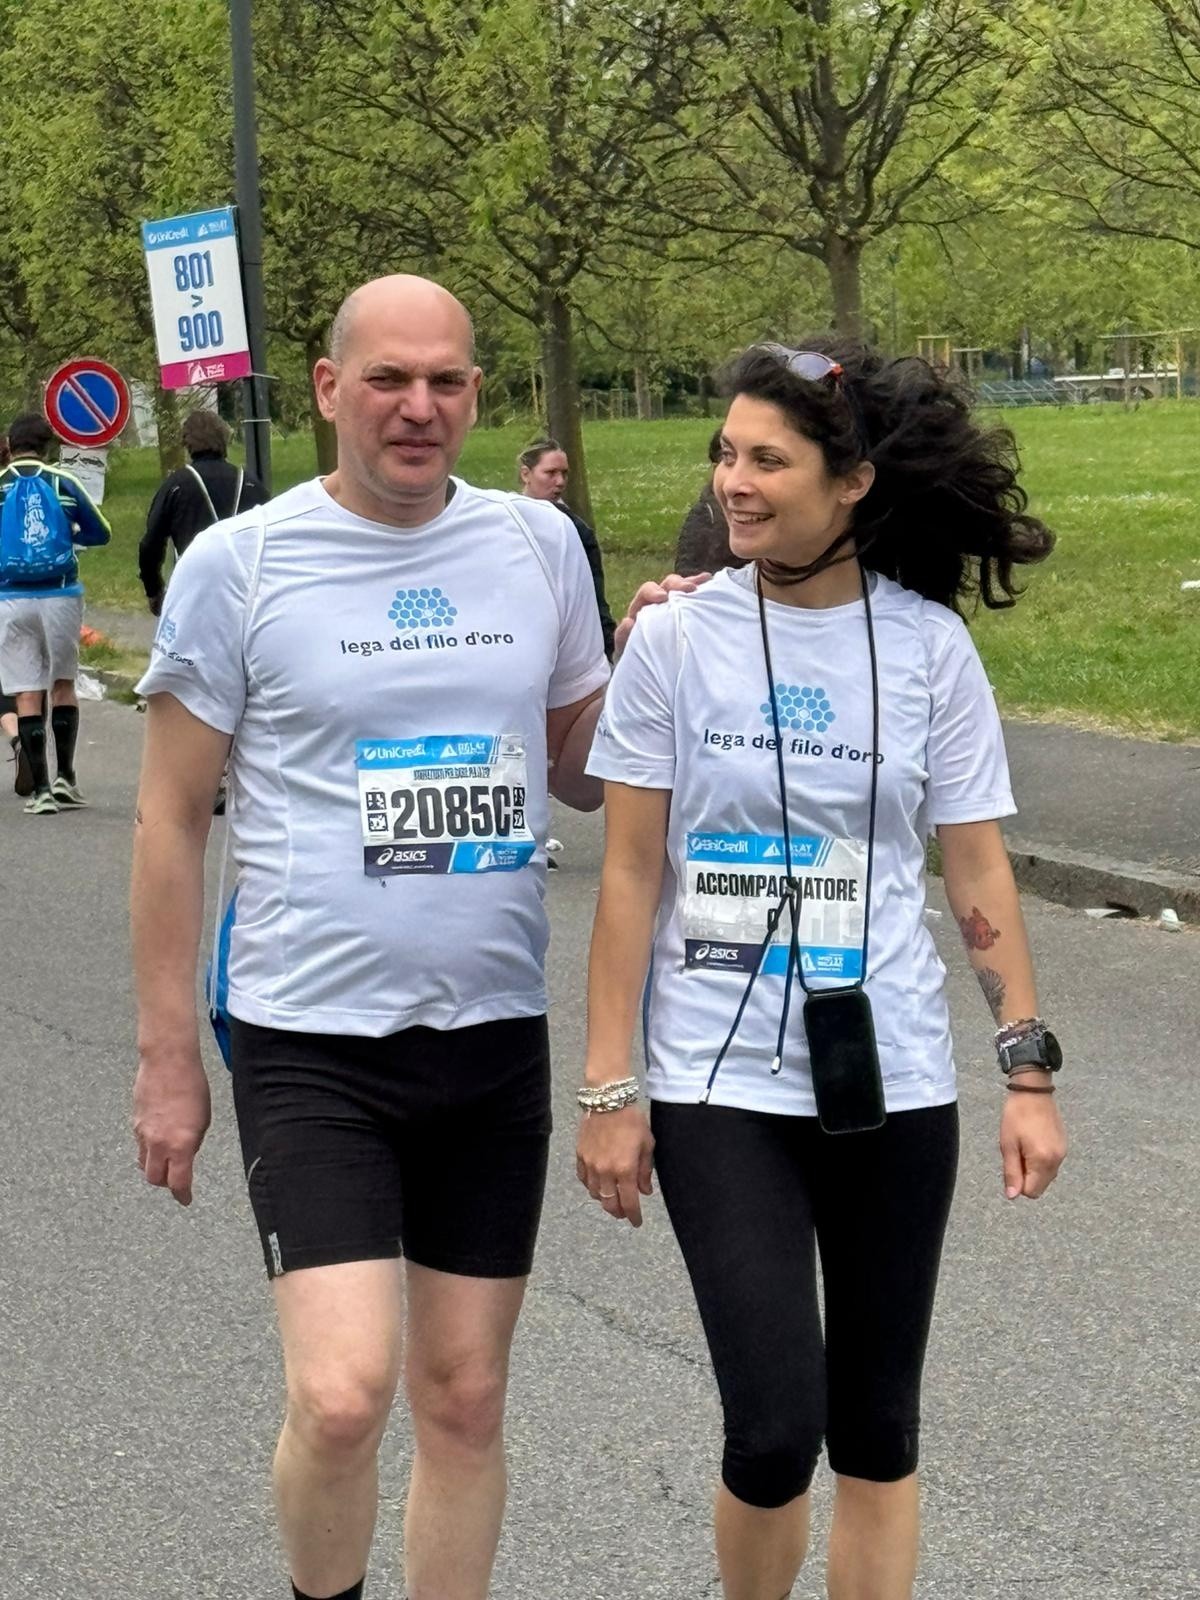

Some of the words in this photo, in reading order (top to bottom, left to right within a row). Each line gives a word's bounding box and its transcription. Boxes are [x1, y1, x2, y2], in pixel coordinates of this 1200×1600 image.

[173, 250, 215, 292] 801
[178, 310, 224, 352] 900
[340, 639, 384, 657] lega
[389, 635, 420, 651] del
[426, 633, 458, 649] filo
[465, 631, 514, 646] d'oro
[703, 728, 744, 751] lega
[752, 733, 782, 751] de
[790, 738, 823, 757] filo
[831, 743, 885, 765] d'oro
[390, 785, 511, 840] 2085C
[394, 850, 427, 862] asics
[709, 947, 739, 960] asics
